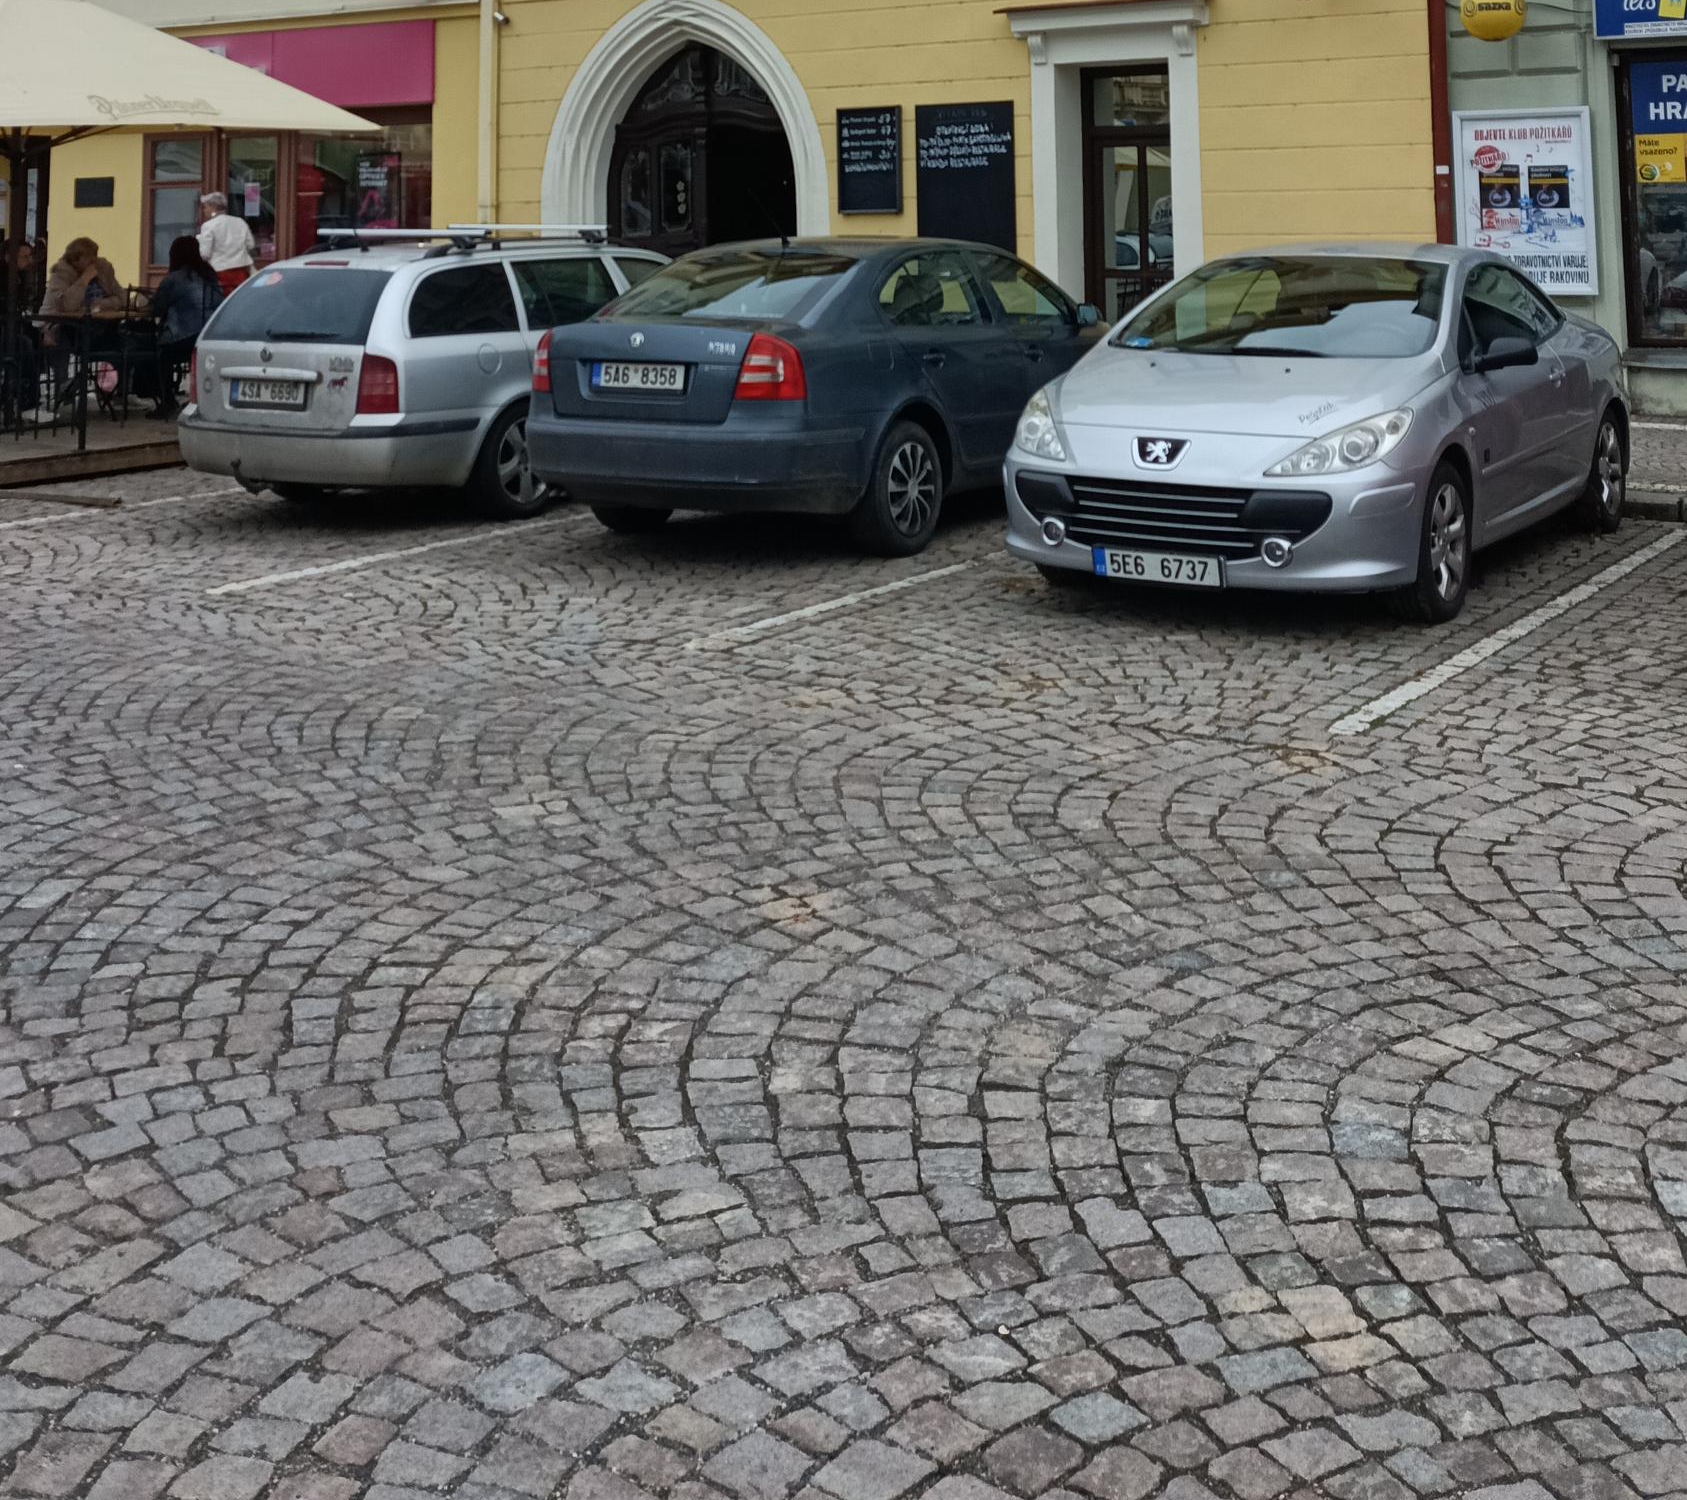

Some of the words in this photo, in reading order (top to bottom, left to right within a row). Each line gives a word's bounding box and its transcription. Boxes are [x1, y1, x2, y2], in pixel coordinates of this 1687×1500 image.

[1508, 128, 1528, 140] KLUB
[1640, 147, 1678, 156] vsazeno?
[1549, 271, 1590, 285] RAKOVINU
[603, 365, 630, 384] 5A6
[640, 366, 678, 386] 8358
[240, 384, 261, 399] 4SA
[270, 384, 300, 401] 6690
[1109, 553, 1146, 576] 5E6
[1160, 558, 1209, 582] 6737
